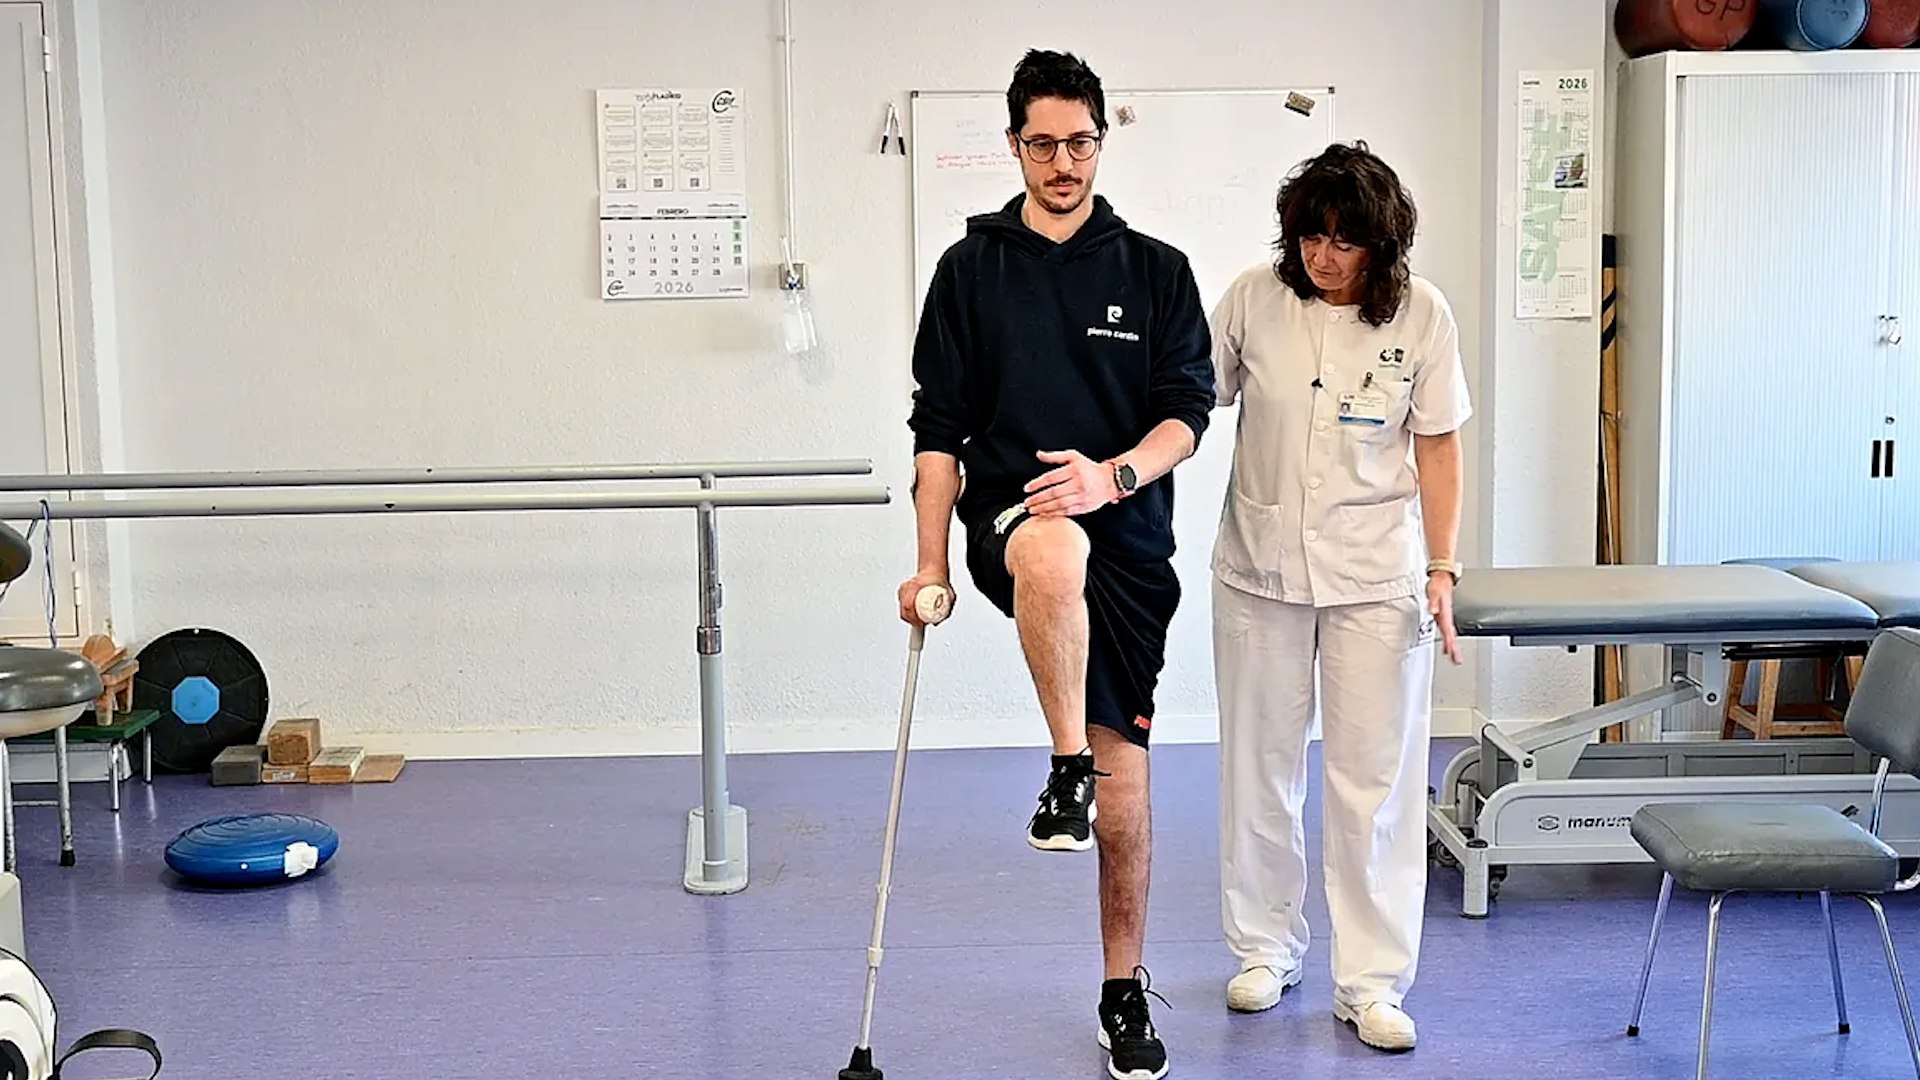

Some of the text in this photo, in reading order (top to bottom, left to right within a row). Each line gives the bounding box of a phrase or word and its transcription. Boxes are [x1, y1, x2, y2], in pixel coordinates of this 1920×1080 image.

[1559, 79, 1588, 89] 2026
[657, 208, 689, 216] FEBRERO
[655, 282, 694, 293] 2026
